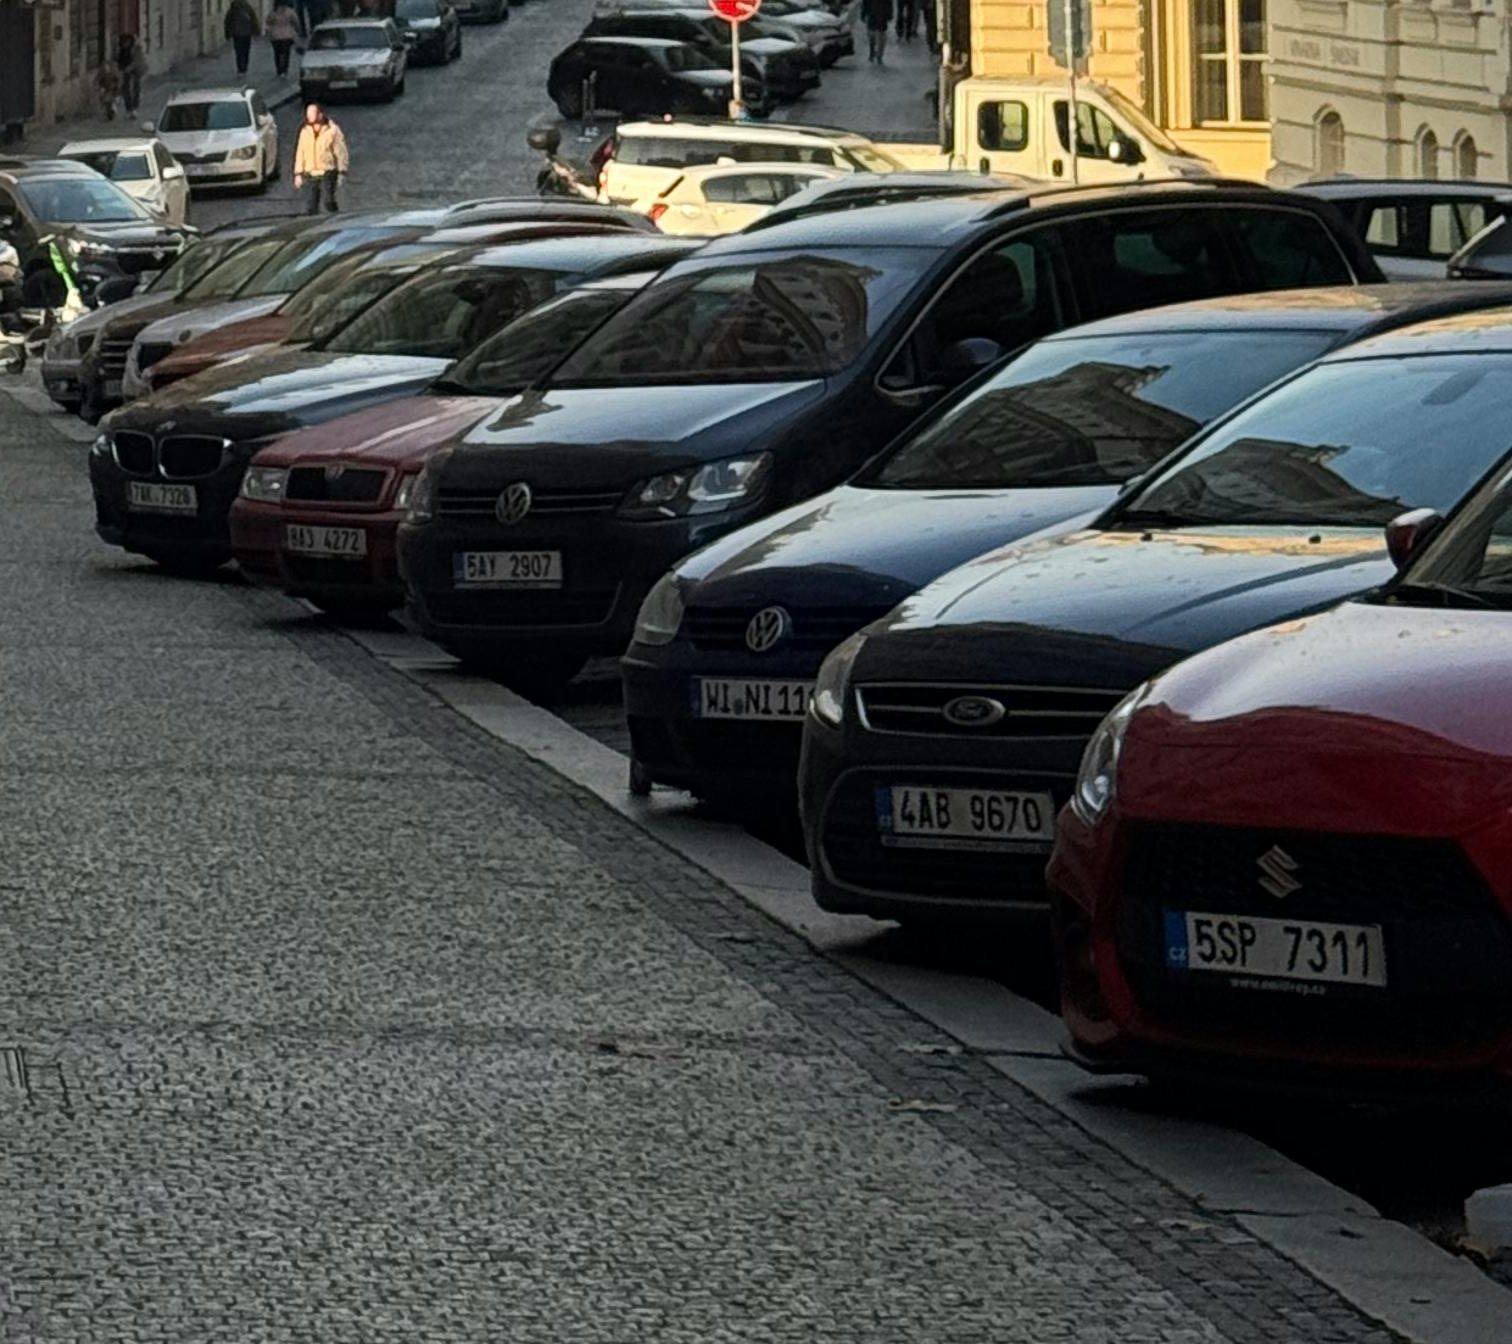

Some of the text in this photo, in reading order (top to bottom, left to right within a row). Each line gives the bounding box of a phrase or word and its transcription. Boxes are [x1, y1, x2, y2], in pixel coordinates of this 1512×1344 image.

[324, 529, 359, 552] 4272
[467, 554, 551, 578] 5AY 2907
[901, 790, 1042, 833] 4AB 9670
[1194, 919, 1369, 978] 5SP 7311
